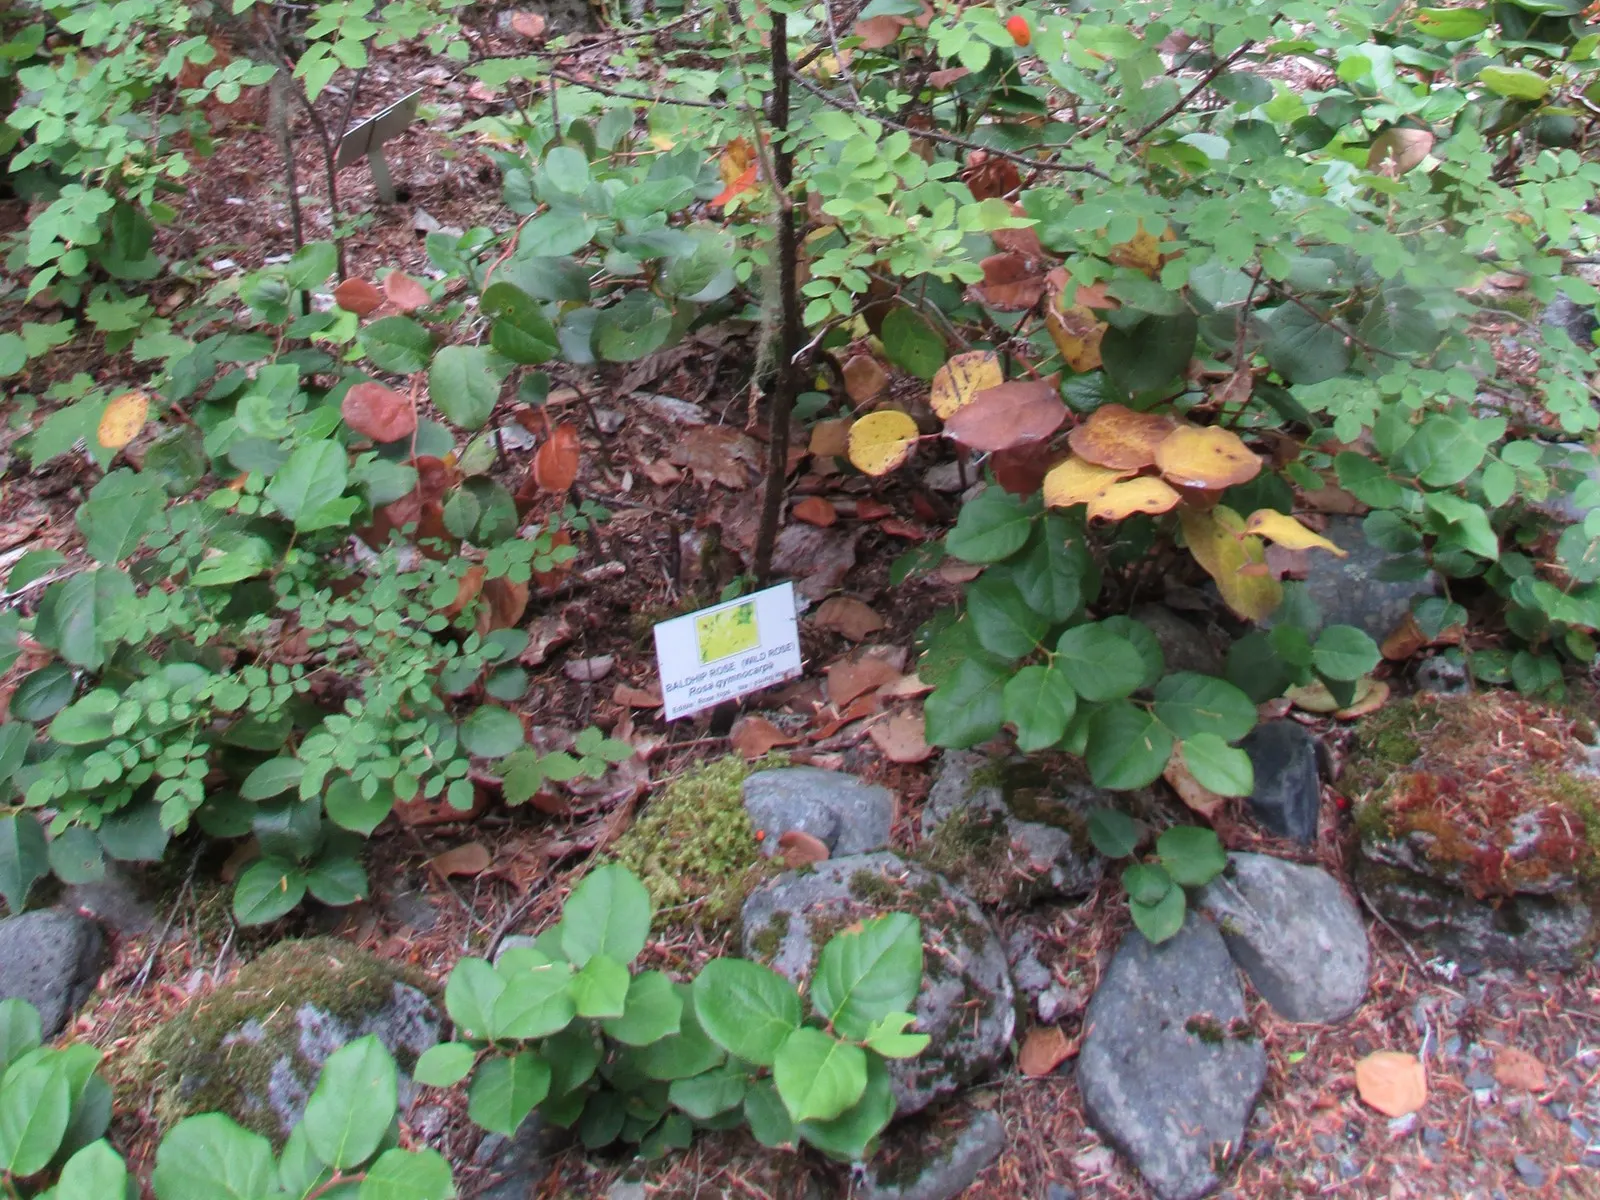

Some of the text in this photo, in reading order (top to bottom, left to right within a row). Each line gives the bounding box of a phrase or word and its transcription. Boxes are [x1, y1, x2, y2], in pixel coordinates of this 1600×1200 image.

[666, 641, 796, 693] BALDHIP ROSE (WILD ROSE)
[688, 681, 714, 699] Rosa
[715, 661, 775, 689] gymnocarpa
